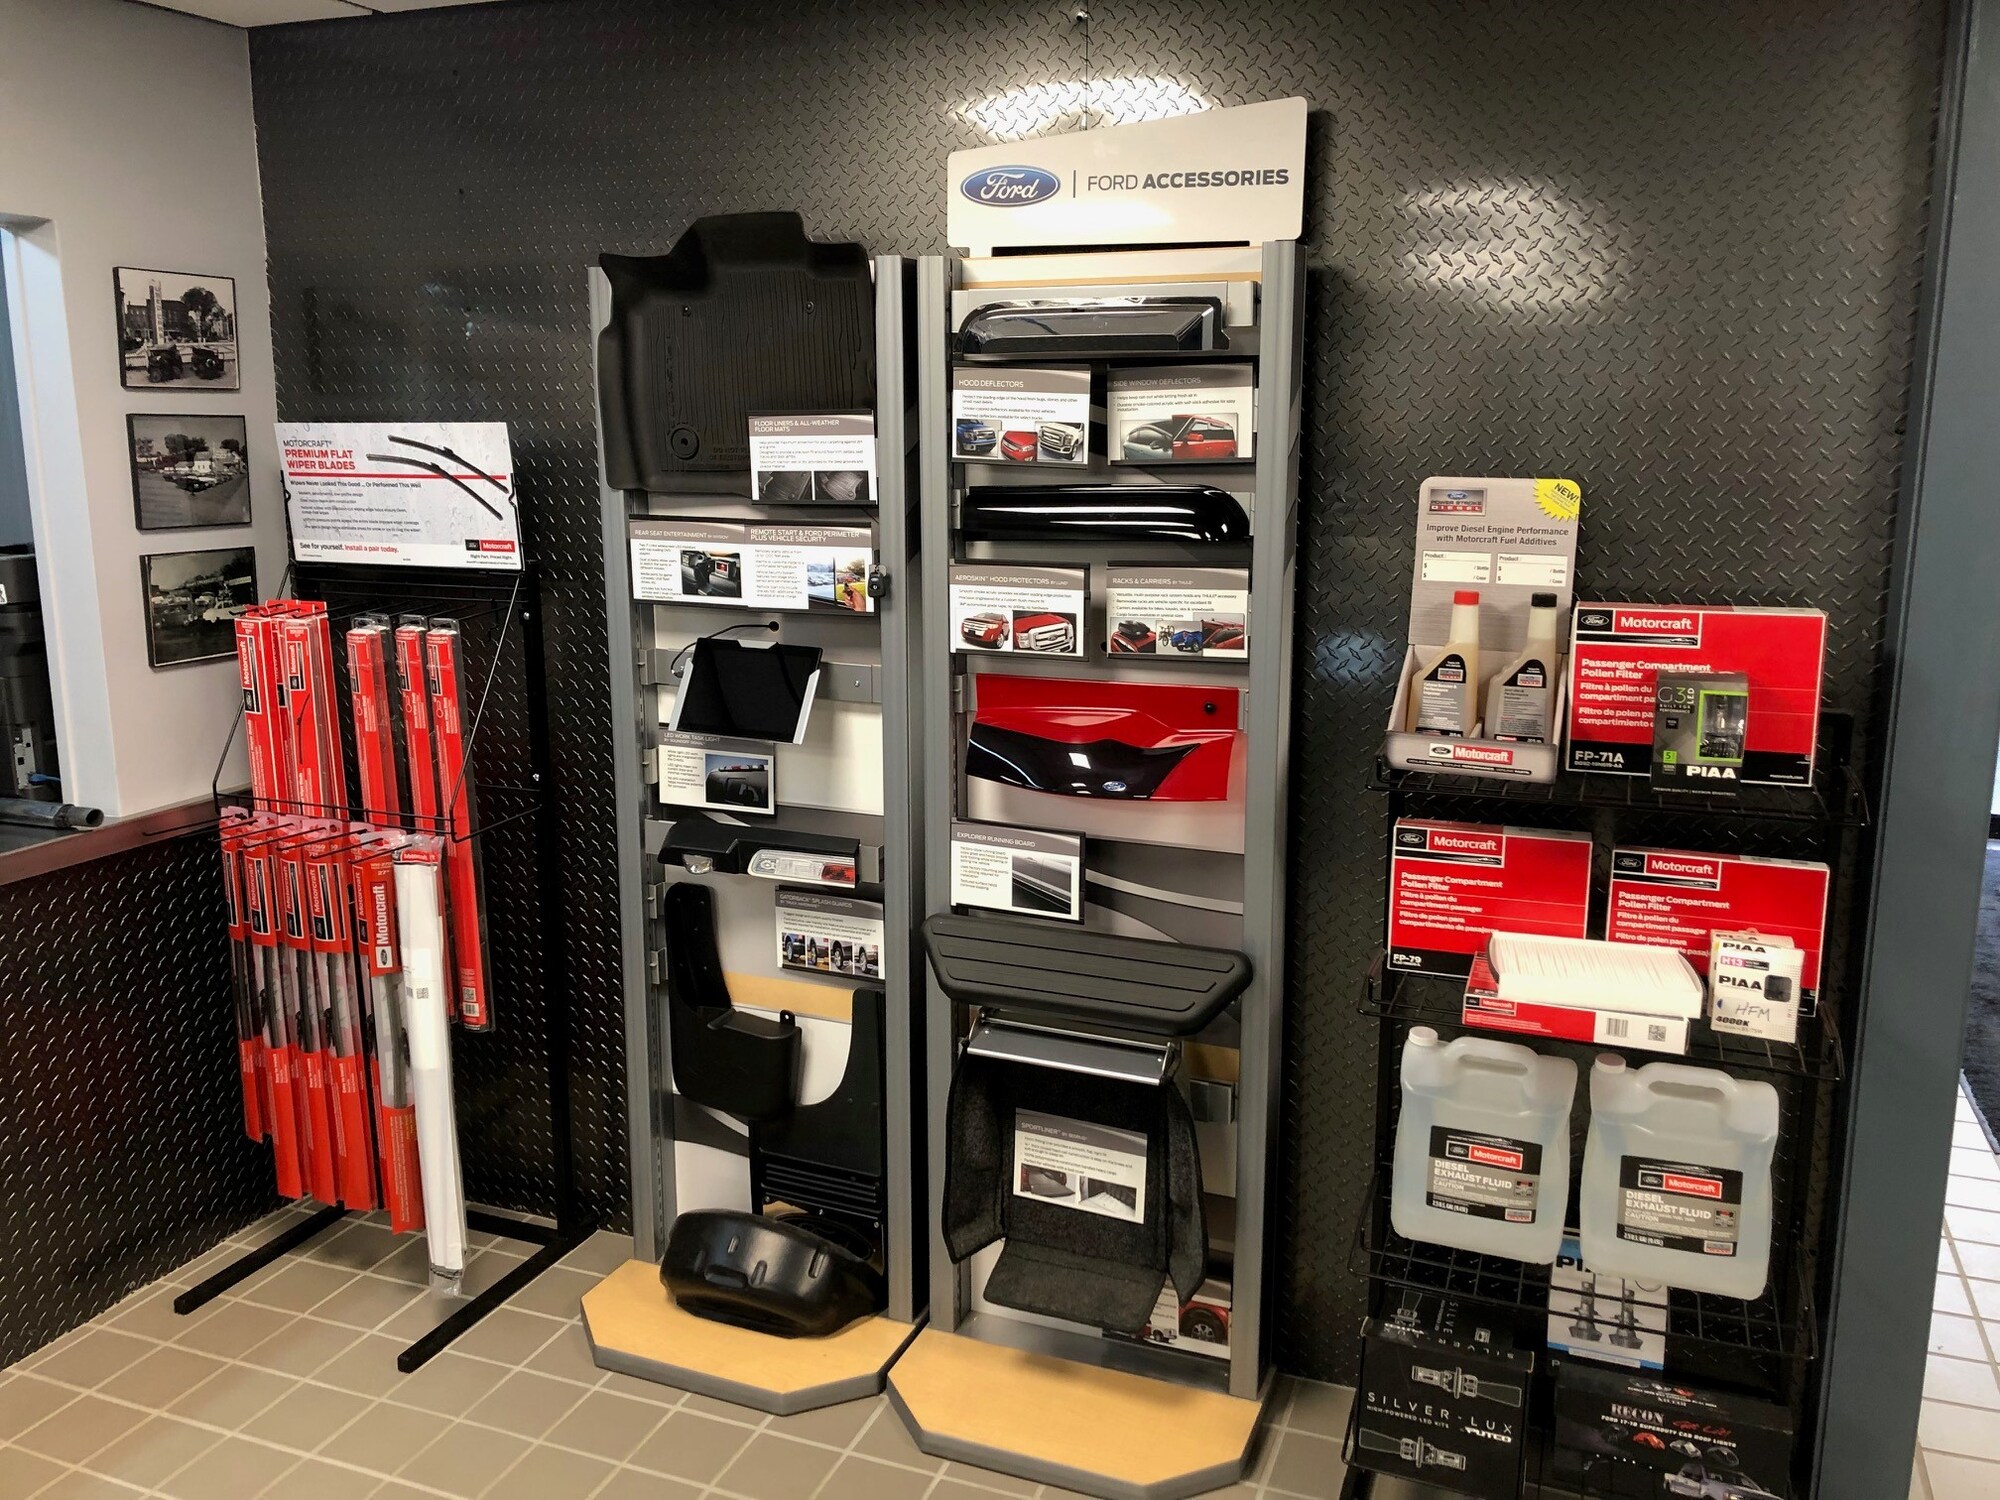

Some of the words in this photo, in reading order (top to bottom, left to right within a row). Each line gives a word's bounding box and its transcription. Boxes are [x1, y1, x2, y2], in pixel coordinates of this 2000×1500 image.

[980, 173, 1039, 199] Ford
[1088, 175, 1138, 192] FORD
[1142, 168, 1289, 189] ACCESSORIES
[980, 380, 1024, 388] DEFLECTORS
[1160, 377, 1201, 385] DEFLECTORS
[285, 449, 328, 459] PREMIUM
[330, 450, 353, 459] FLAT
[287, 461, 316, 470] WIPER
[318, 461, 356, 470] BLADES
[1554, 483, 1579, 501] NEW!
[1426, 524, 1459, 534] Improve
[1461, 525, 1485, 533] Diesel
[1487, 526, 1514, 535] Engine
[1517, 526, 1569, 536] Performance
[483, 542, 512, 550] Motorcraft
[1456, 535, 1498, 544] Motorcraft
[1520, 537, 1557, 546] Additives
[1009, 576, 1050, 584] PROTECTORS
[1621, 617, 1692, 630] Motorcraft
[238, 640, 250, 685] Motorcraft
[1582, 659, 1636, 670] Passenger
[1637, 661, 1711, 672] Compartment
[1581, 669, 1614, 678] Pollen
[1616, 670, 1643, 680] Filter
[1580, 683, 1604, 691] Filtre
[1612, 684, 1639, 694] pollen
[1640, 685, 1652, 693] du
[1580, 693, 1642, 704] compartiment
[1579, 707, 1602, 716] Filtro
[1603, 709, 1615, 717] de
[1616, 709, 1640, 719] polen
[1578, 718, 1649, 728] compartimiento
[1455, 747, 1509, 762] Motorcraft
[1574, 750, 1625, 764] FP-71A
[1686, 766, 1736, 779] PIAA
[957, 832, 986, 840] EXPLORER
[987, 836, 1014, 844] RUNNING
[1015, 839, 1036, 847] BOARD
[1434, 836, 1497, 850] Motorcraft
[1652, 860, 1713, 875] Motorcraft
[248, 862, 258, 908] Motorcraft
[1401, 872, 1444, 883] Passenger
[1445, 875, 1503, 888] Compartment
[1401, 880, 1427, 889] Pollen
[1428, 882, 1449, 891] Filter
[310, 867, 321, 913] Motorcraft
[353, 872, 365, 916] Motorcraft
[1618, 900, 1646, 909] Pollen
[1648, 902, 1671, 912] Filter
[1619, 891, 1665, 903] Passenger
[1666, 895, 1730, 910] Compartment
[375, 884, 387, 946] Motorcraft
[1617, 911, 1637, 920] Filtre
[1644, 914, 1668, 924] pollen
[1616, 919, 1669, 933] compartiment
[1671, 926, 1707, 936] passager
[1723, 942, 1766, 953] PIAA
[1721, 956, 1743, 967] H13
[1719, 975, 1762, 990] PIAA
[1474, 1149, 1516, 1164] Motorcraft
[1434, 1160, 1469, 1173] DIESEL
[1433, 1179, 1464, 1191] CAUTION
[1434, 1168, 1481, 1183] EXHAUST
[1483, 1176, 1512, 1189] FLUID
[1668, 1179, 1715, 1193] Motorcraft
[1626, 1191, 1664, 1204] DIESEL
[1626, 1200, 1677, 1215] EXHAUST
[1679, 1208, 1712, 1220] FLUID
[1611, 1404, 1664, 1426] RECON
[1465, 1427, 1512, 1443] PUTCO
